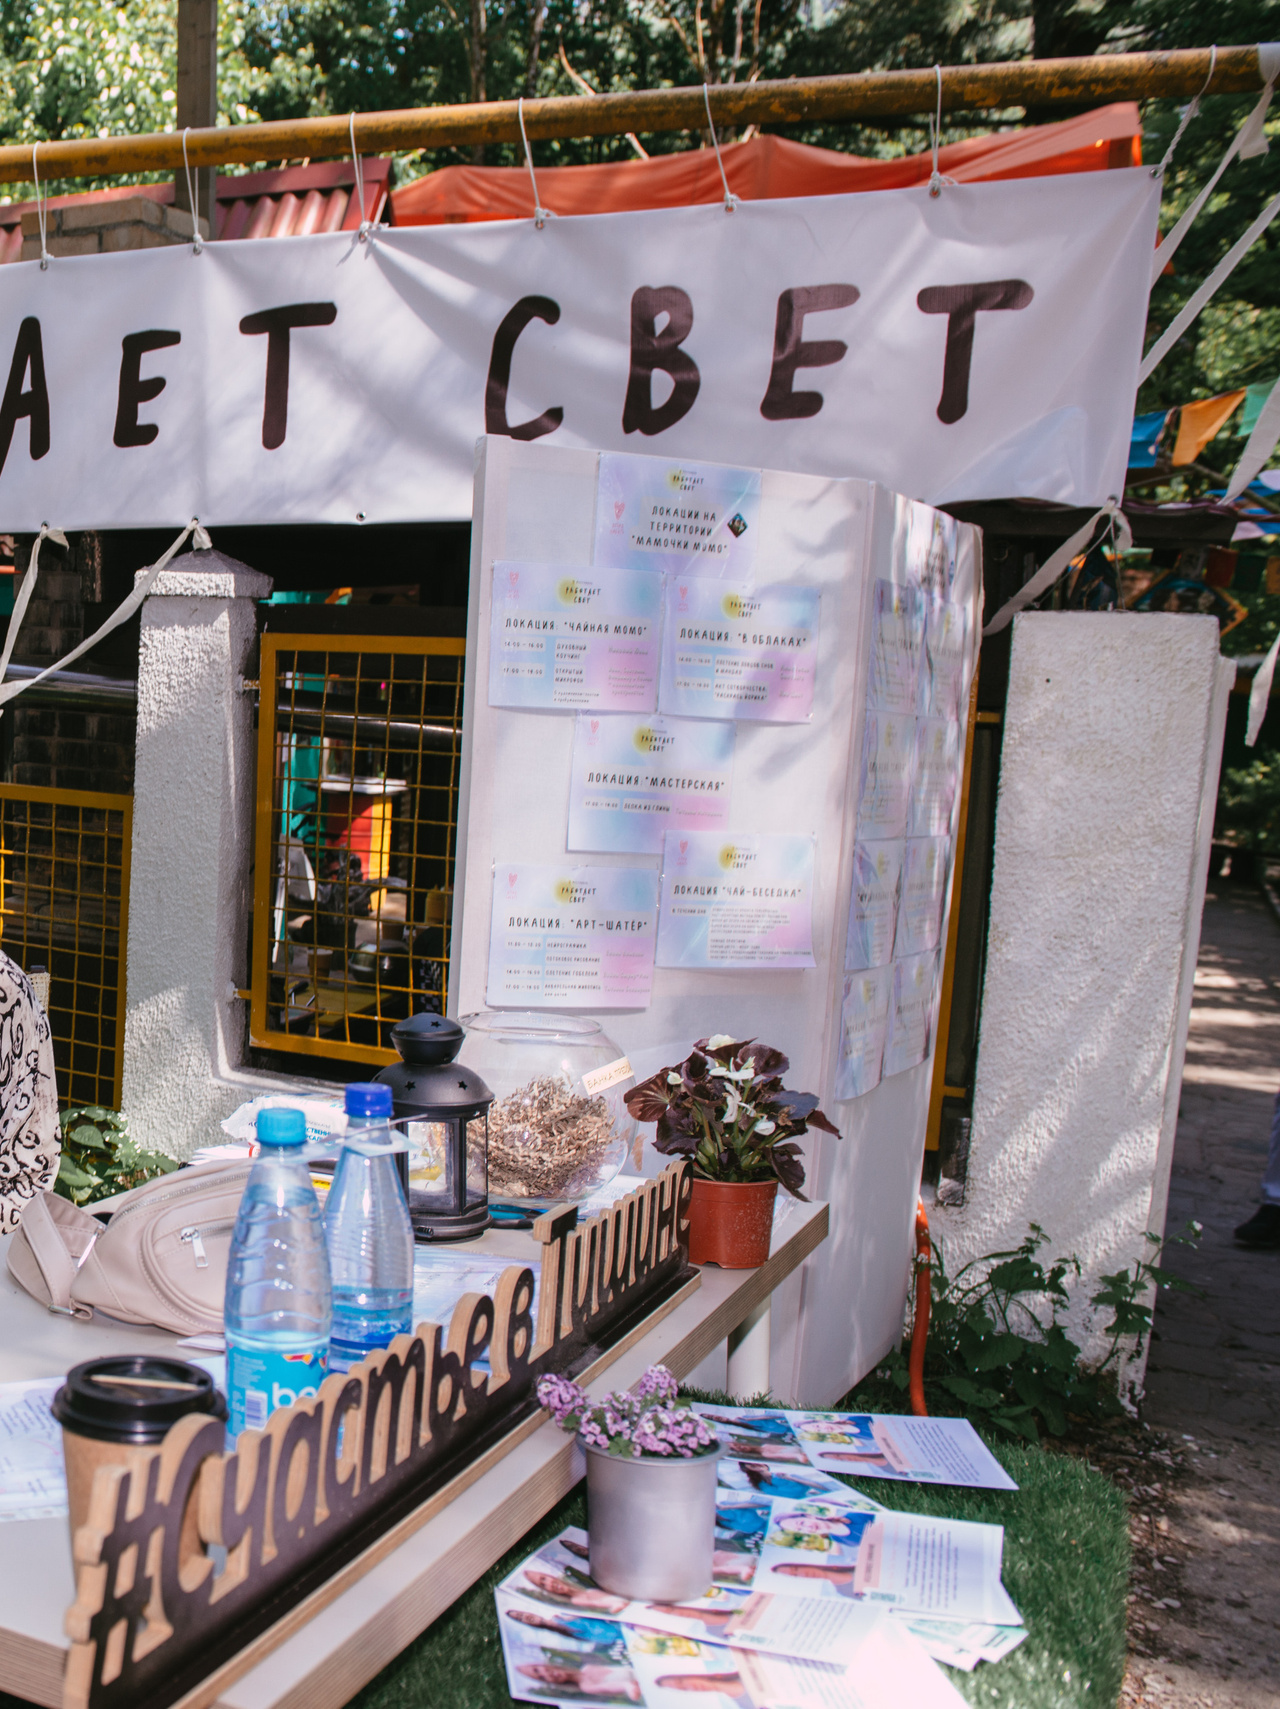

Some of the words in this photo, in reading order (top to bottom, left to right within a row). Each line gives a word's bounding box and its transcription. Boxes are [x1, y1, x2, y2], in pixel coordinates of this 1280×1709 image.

[485, 278, 1035, 440] СВЕТ
[652, 506, 700, 520] ЛОКАЦИИ
[703, 512, 716, 521] НА
[650, 521, 712, 536] ТЕРРИТОРИИ
[631, 535, 689, 549] "МАМОЧКИ
[752, 634, 806, 647] ОБЛАКАХ"
[645, 776, 725, 791] "МАСТЕРСКАЯ"
[673, 884, 718, 895] ЛОКАЦИЯ
